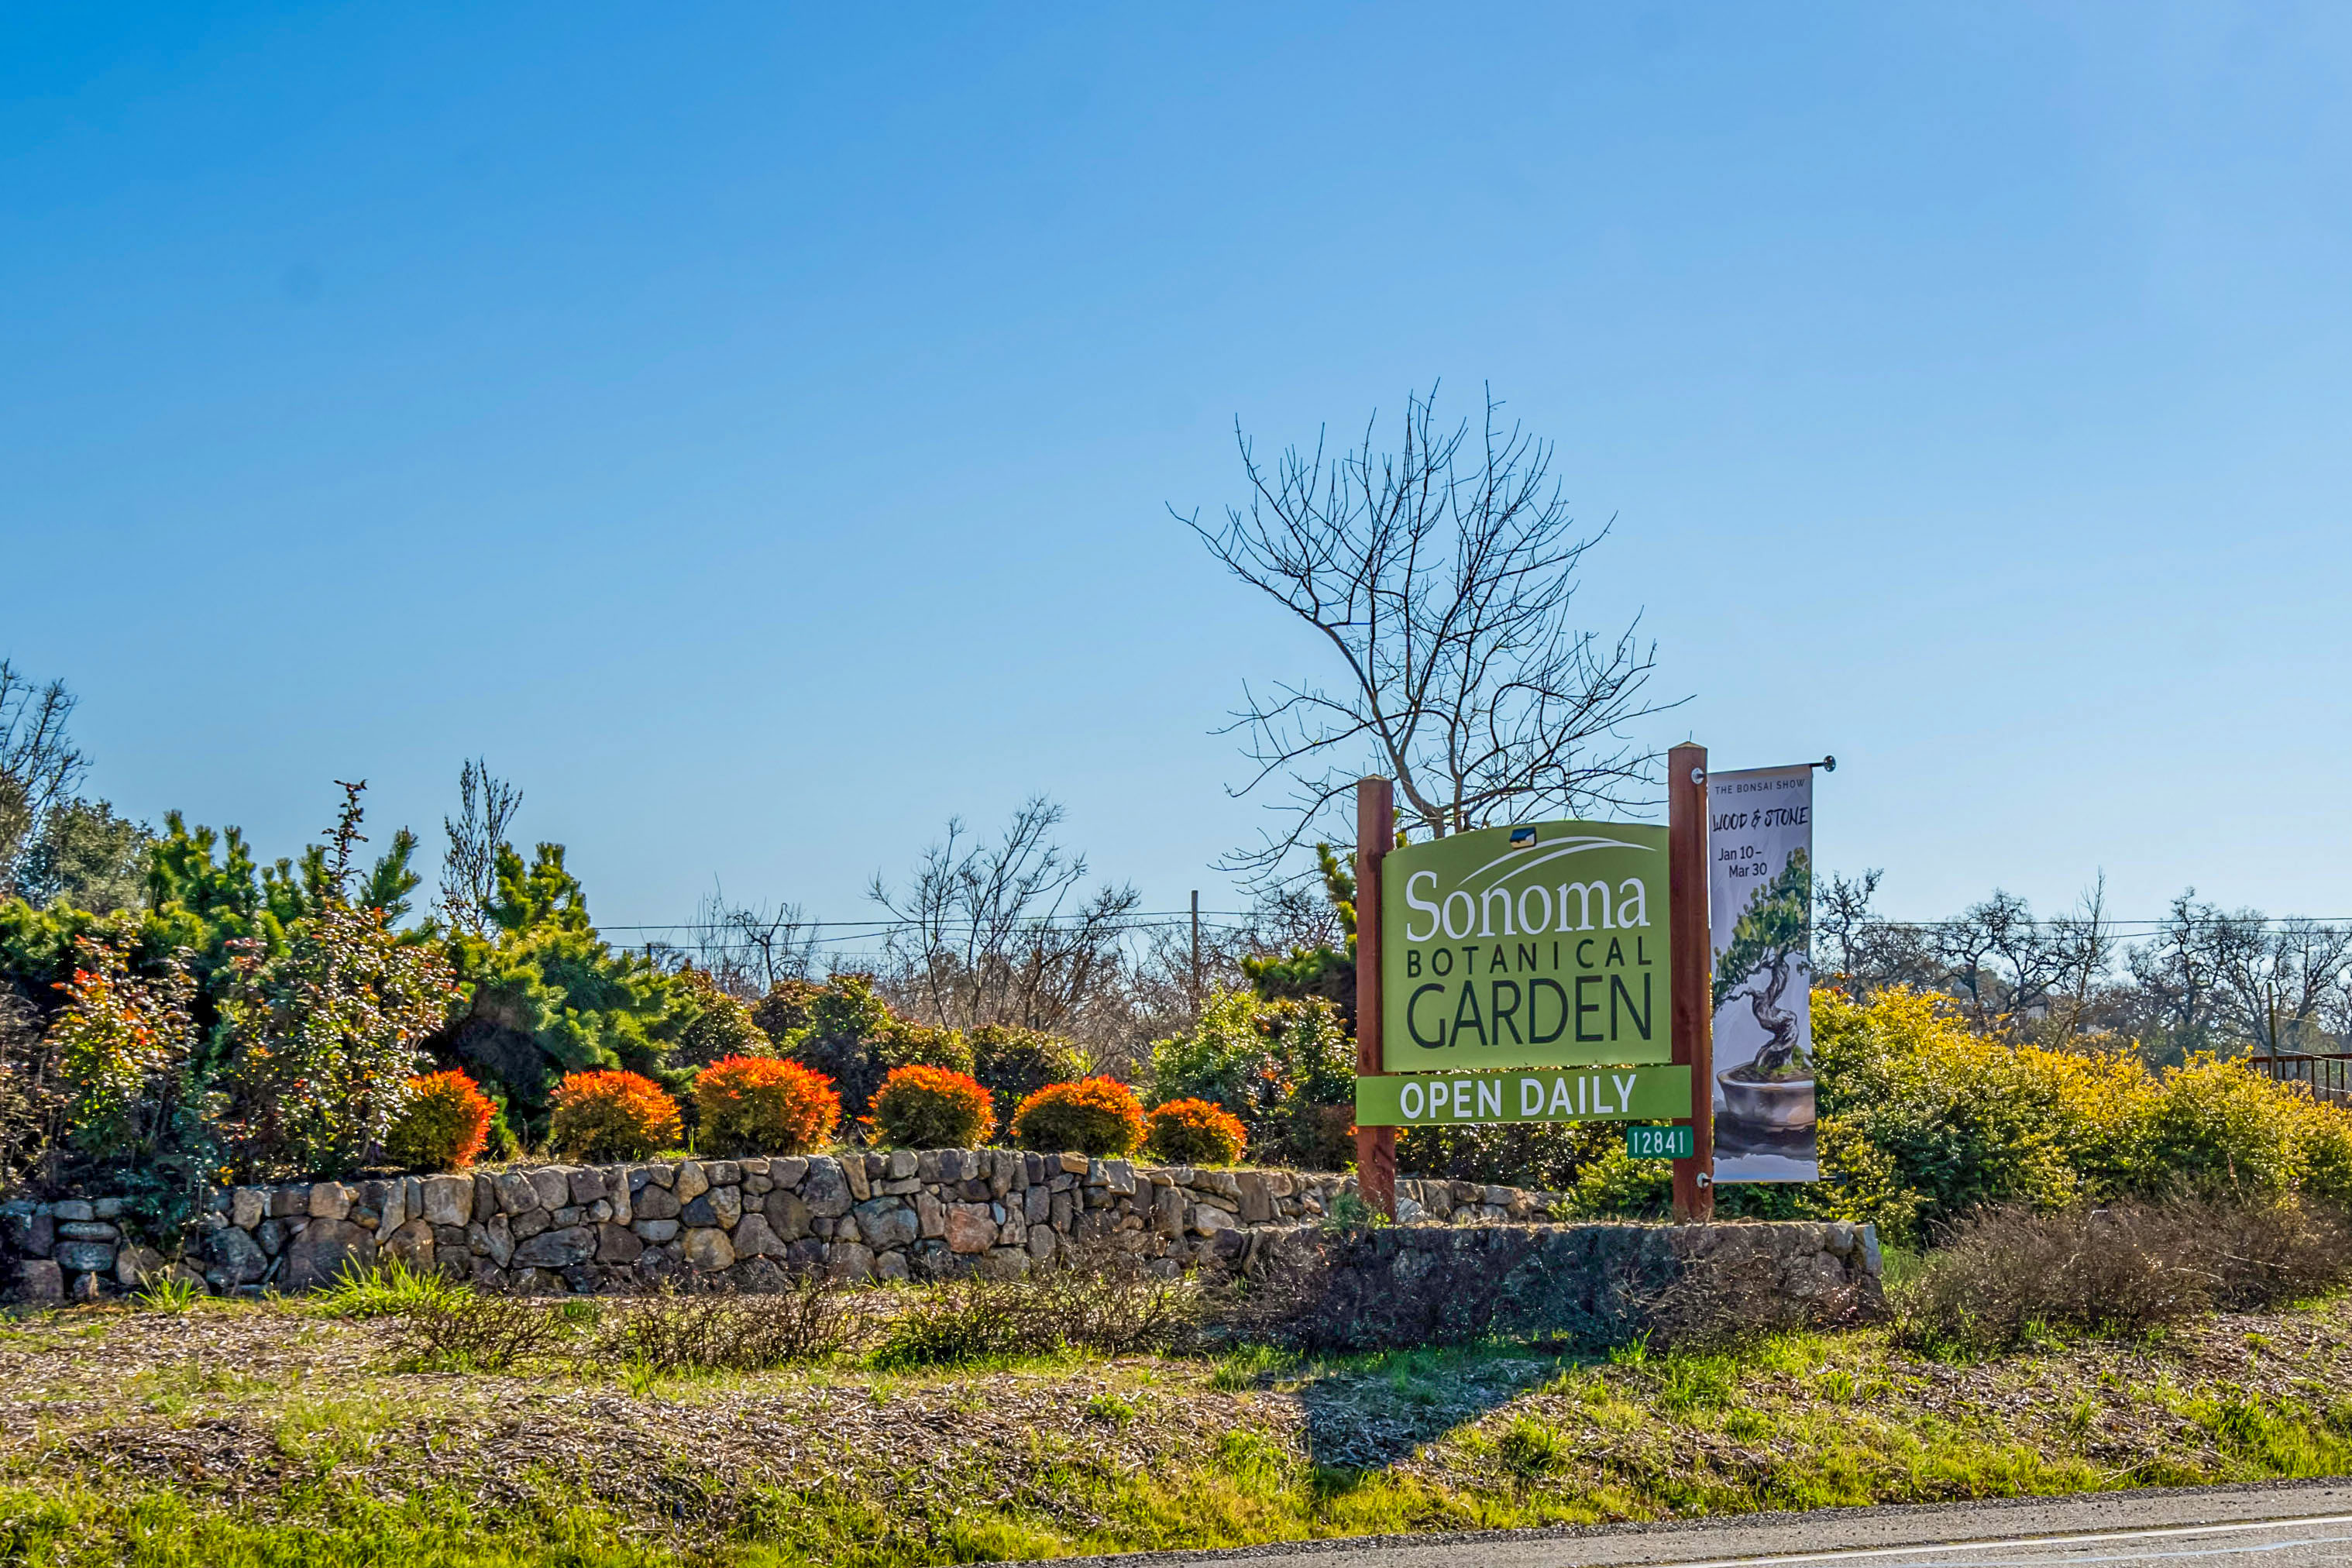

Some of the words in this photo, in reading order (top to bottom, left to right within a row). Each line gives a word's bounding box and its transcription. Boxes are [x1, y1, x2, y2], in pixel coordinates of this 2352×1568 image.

[1715, 786, 1733, 795] THE
[1737, 782, 1773, 793] BONSAI
[1776, 779, 1805, 789] SHOW
[1713, 813, 1748, 832] WOOD
[1751, 808, 1762, 830] &
[1765, 806, 1809, 827] STONE
[1718, 848, 1737, 861] Jan
[1729, 865, 1749, 878] Mar
[1752, 862, 1767, 876] 30
[1405, 870, 1651, 942] Sonoma
[1407, 936, 1652, 978] BOTANICAL
[1407, 972, 1651, 1049] GARDEN
[1399, 1079, 1501, 1119] OPEN
[1520, 1074, 1637, 1116] DAILY
[1633, 1130, 1684, 1154] 12841
